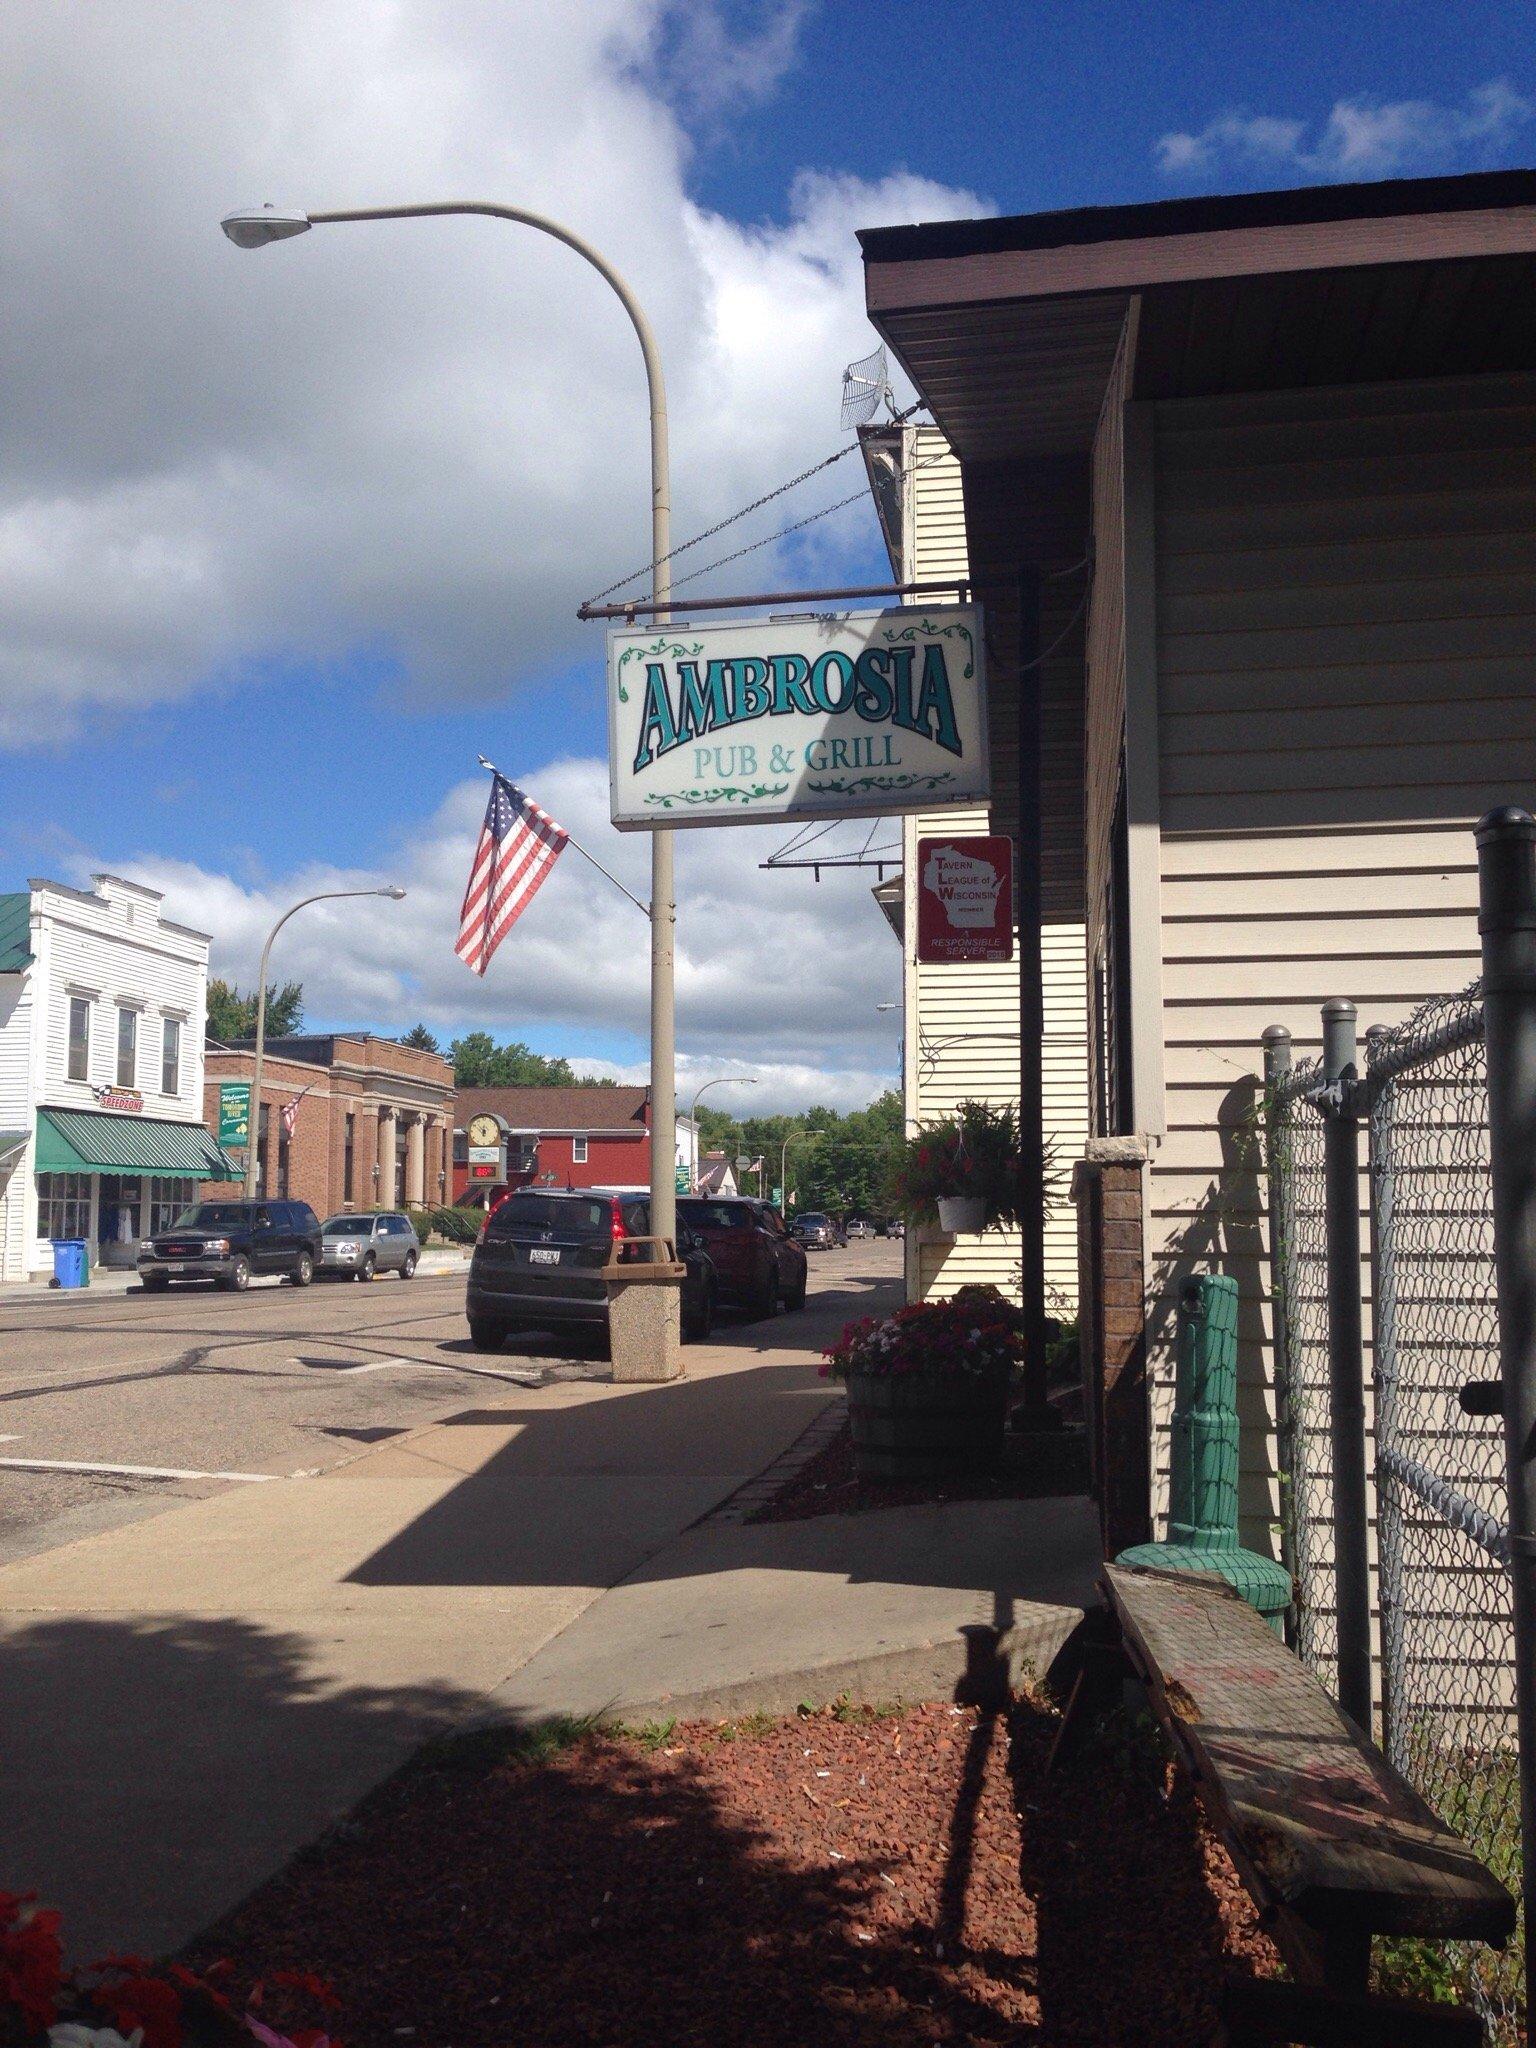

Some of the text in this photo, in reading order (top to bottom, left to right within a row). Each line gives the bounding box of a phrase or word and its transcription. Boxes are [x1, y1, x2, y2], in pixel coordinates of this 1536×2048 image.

[633, 643, 963, 775] AMBROSIA
[694, 735, 902, 779] PUB & GRILL
[935, 857, 973, 870] TAVERN
[938, 873, 990, 885] LEAGUE of
[938, 887, 996, 900] WISCONSIN
[931, 938, 1000, 947] RESPONSIBLE
[946, 946, 986, 955] SERVER
[101, 1096, 144, 1111] SPEEDZONE
[221, 1093, 249, 1102] Welcome
